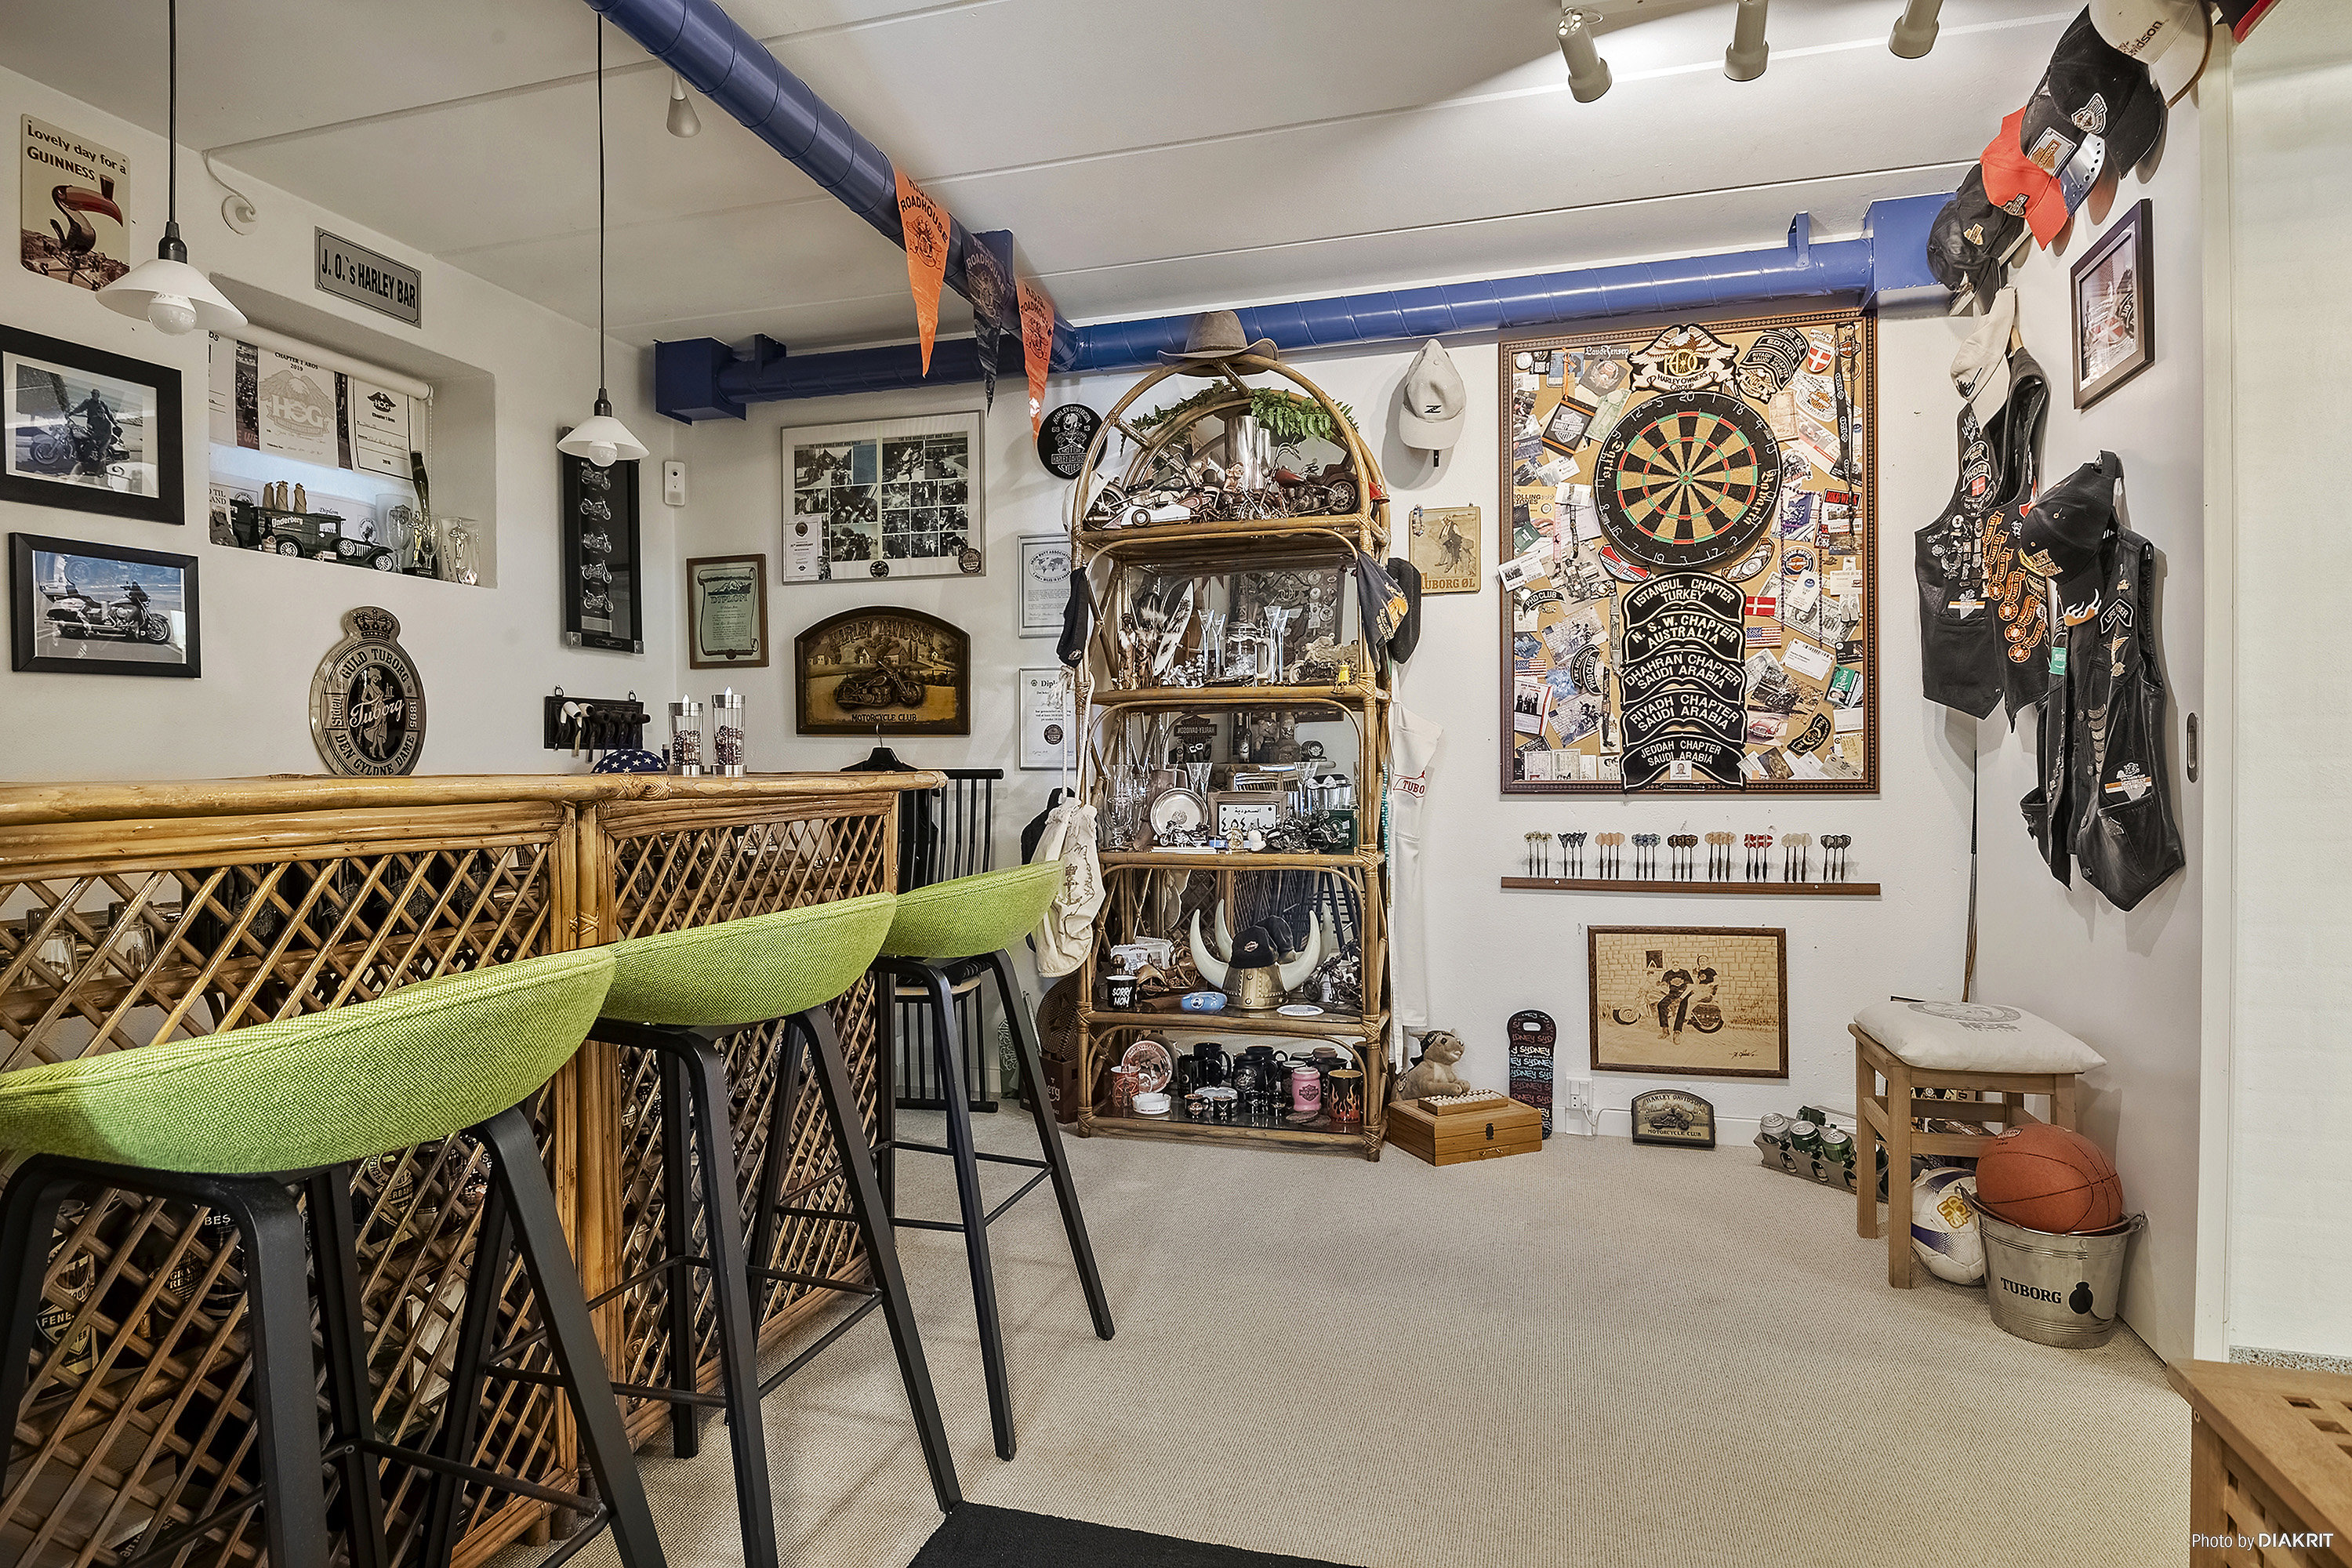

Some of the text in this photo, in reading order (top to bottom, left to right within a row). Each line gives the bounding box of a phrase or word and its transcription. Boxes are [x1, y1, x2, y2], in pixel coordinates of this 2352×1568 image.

[27, 123, 127, 175] Lovely day for a
[27, 146, 96, 181] GUINNESS
[900, 194, 949, 244] ROADHOUSE
[321, 249, 416, 310] J. HARLEY BAR
[1779, 328, 1806, 350] JENS OLE
[1766, 339, 1798, 360] EDITOR
[274, 352, 299, 365] CHAPTER
[290, 363, 303, 372] 2019
[1773, 357, 1788, 379] CHAPTER
[1657, 372, 1708, 384] HARLEY OWNERS
[1670, 382, 1694, 392] GROUP
[1657, 399, 1664, 408] 5
[1679, 390, 1695, 402] 20
[1052, 405, 1091, 425] HARLEY DAVIDSON
[1630, 408, 1643, 422] 12
[1733, 401, 1746, 416] 18
[1755, 419, 1767, 430] 4
[1062, 445, 1081, 453] MOTOR
[1602, 441, 1624, 479] Darts
[1825, 491, 1859, 506] BIKE WEK
[319, 506, 339, 515] Diplom
[272, 516, 303, 528] Underberg
[1630, 542, 1639, 551] 7
[1706, 547, 1719, 561] 17
[1680, 555, 1688, 564] 3
[1461, 576, 1475, 588] ØL
[710, 594, 748, 604] DIPLOM
[1525, 590, 1557, 607] PHD CLUB
[1632, 578, 1736, 608] ISTANBUL CHAPTER
[1661, 589, 1706, 603] TURKEY
[2104, 608, 2116, 623] LIFE
[829, 619, 935, 648] HARLEY DAVIDSON
[1631, 615, 1737, 644] N. S. W. CHAPTER
[1647, 626, 1719, 650] AUSTRALIA
[342, 648, 409, 684] GULD TUBORG
[1586, 655, 1596, 689] PHD CLUB
[1624, 654, 1742, 687] DHAHRAN CHAPTER
[1637, 666, 1725, 690] SAUDI ARABIA
[349, 696, 405, 728] Tuborg
[408, 700, 418, 729] 1895
[1629, 694, 1740, 724] RIYADH CHAPTER
[851, 713, 917, 722] MOTORCYCLE CLUB
[1637, 706, 1730, 731] SAUDI ARABIA
[335, 734, 355, 760] DEN
[395, 735, 415, 768] DAME
[1640, 740, 1722, 758] JEDDAH CHAPTER
[1647, 751, 1713, 767] SAUDI ARABIA
[1112, 986, 1133, 998] SORRY
[1519, 1046, 1551, 1056] SYDNEY
[1523, 1058, 1553, 1067] SYDNEY
[1512, 1082, 1542, 1091] SYDNEY
[1646, 1094, 1703, 1107] HARLEY DAVIDSON
[2001, 1276, 2062, 1305] TUBORG
